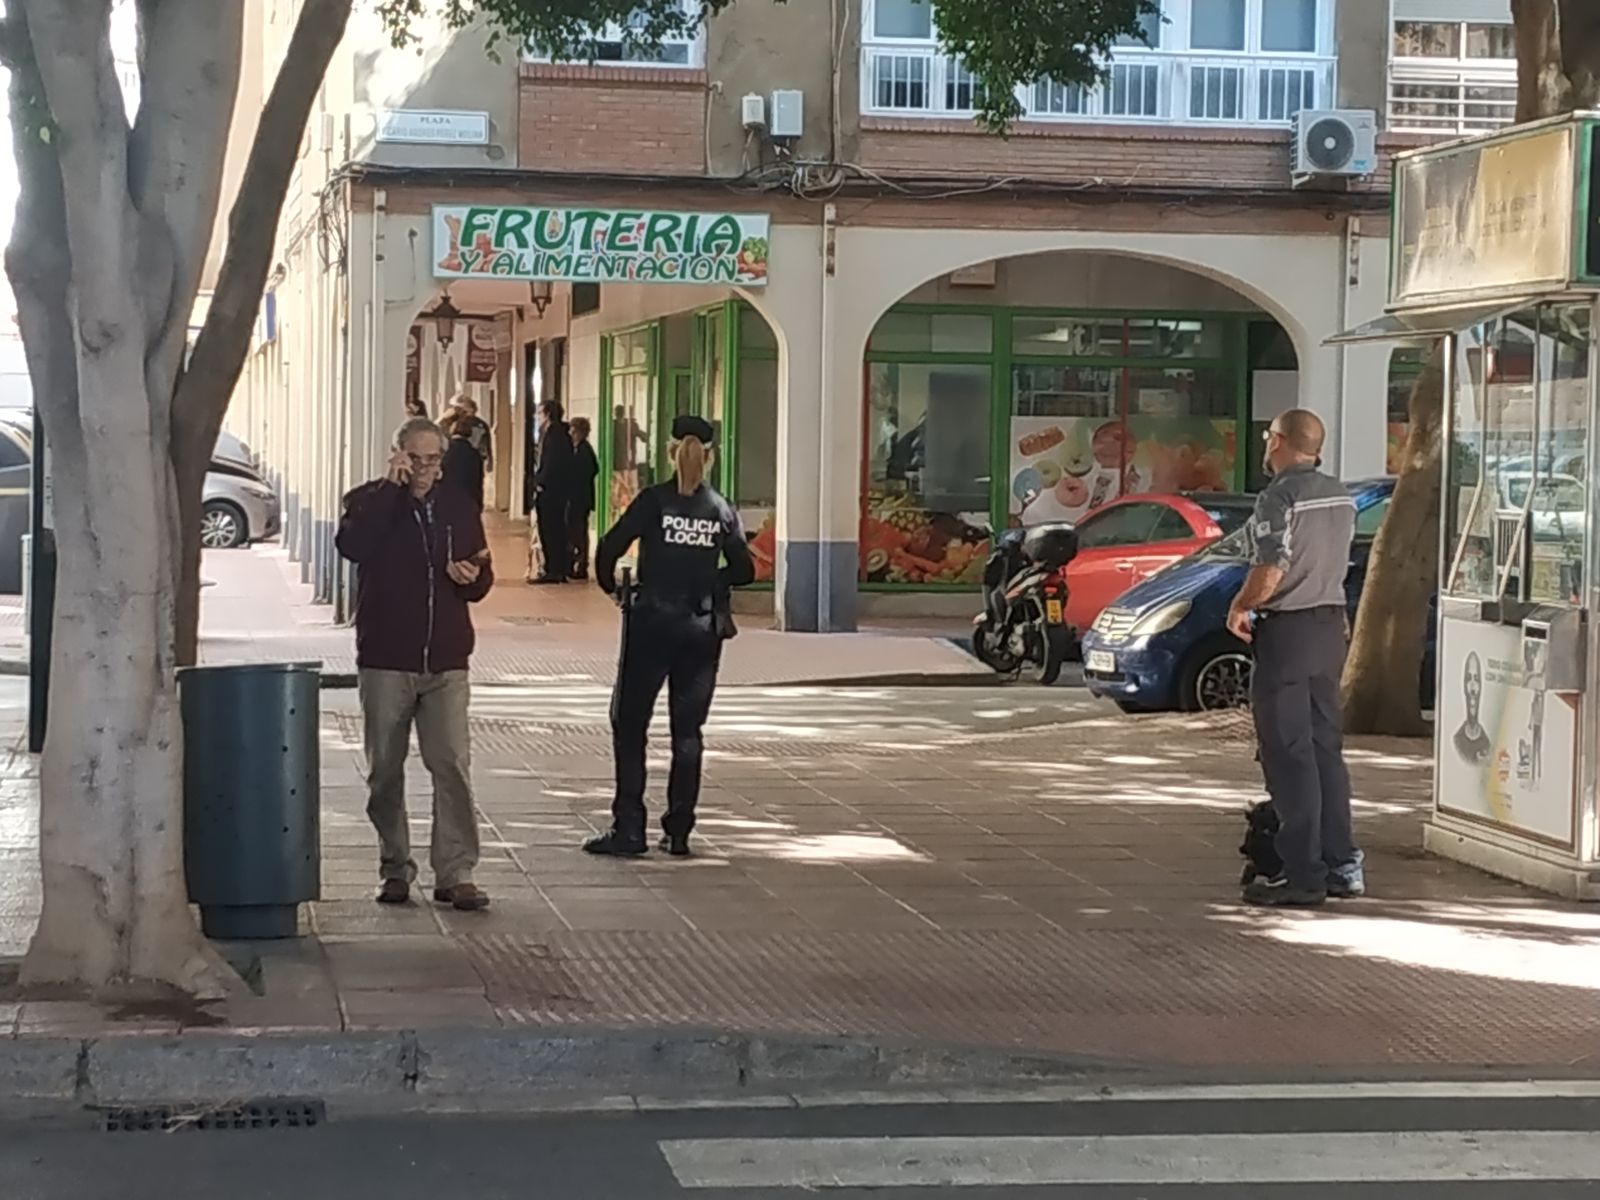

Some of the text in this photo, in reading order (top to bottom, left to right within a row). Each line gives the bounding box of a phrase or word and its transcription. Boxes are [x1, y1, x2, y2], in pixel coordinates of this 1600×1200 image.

[420, 116, 451, 125] PLAZA
[459, 207, 741, 255] FRUTERIA
[459, 252, 737, 282] Y ALIMENTACION
[662, 515, 720, 534] POLICIA
[664, 529, 715, 547] LOCAL
